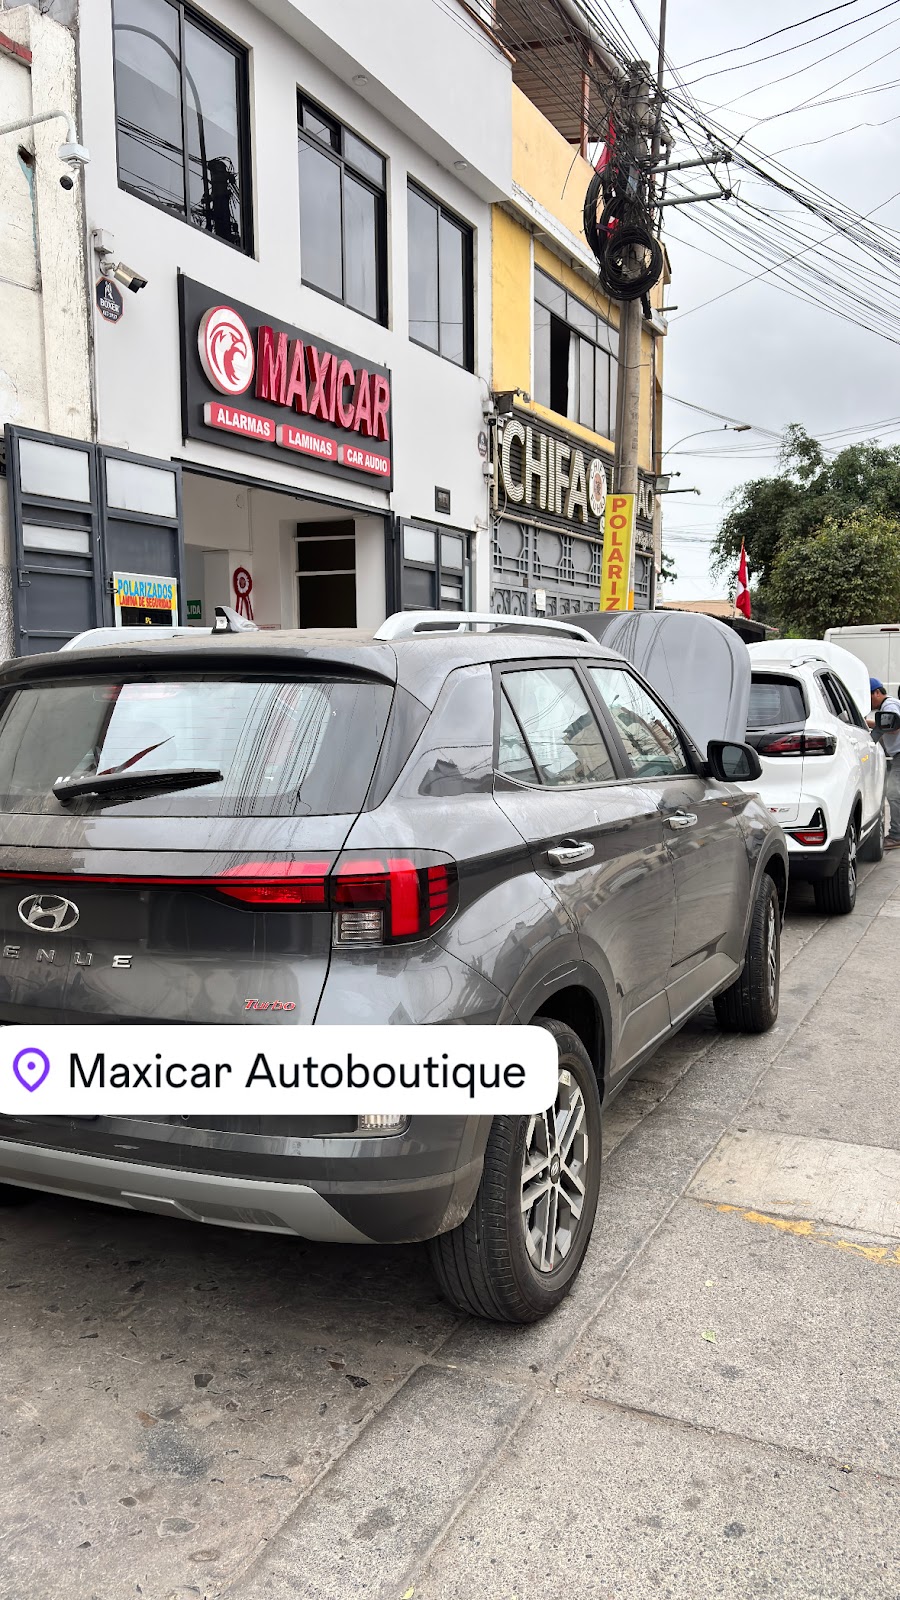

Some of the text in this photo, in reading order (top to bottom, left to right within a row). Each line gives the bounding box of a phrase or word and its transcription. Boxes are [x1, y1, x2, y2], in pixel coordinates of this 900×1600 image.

[255, 325, 390, 442] MAXICAR
[217, 408, 271, 437] ALARMAS
[288, 429, 333, 456] LAMINAS
[346, 448, 388, 473] CAR AUDIO
[502, 420, 589, 523] CHIFA
[117, 579, 173, 600] POLARIZADOS
[138, 596, 145, 607] DE
[244, 998, 297, 1012] Turbo
